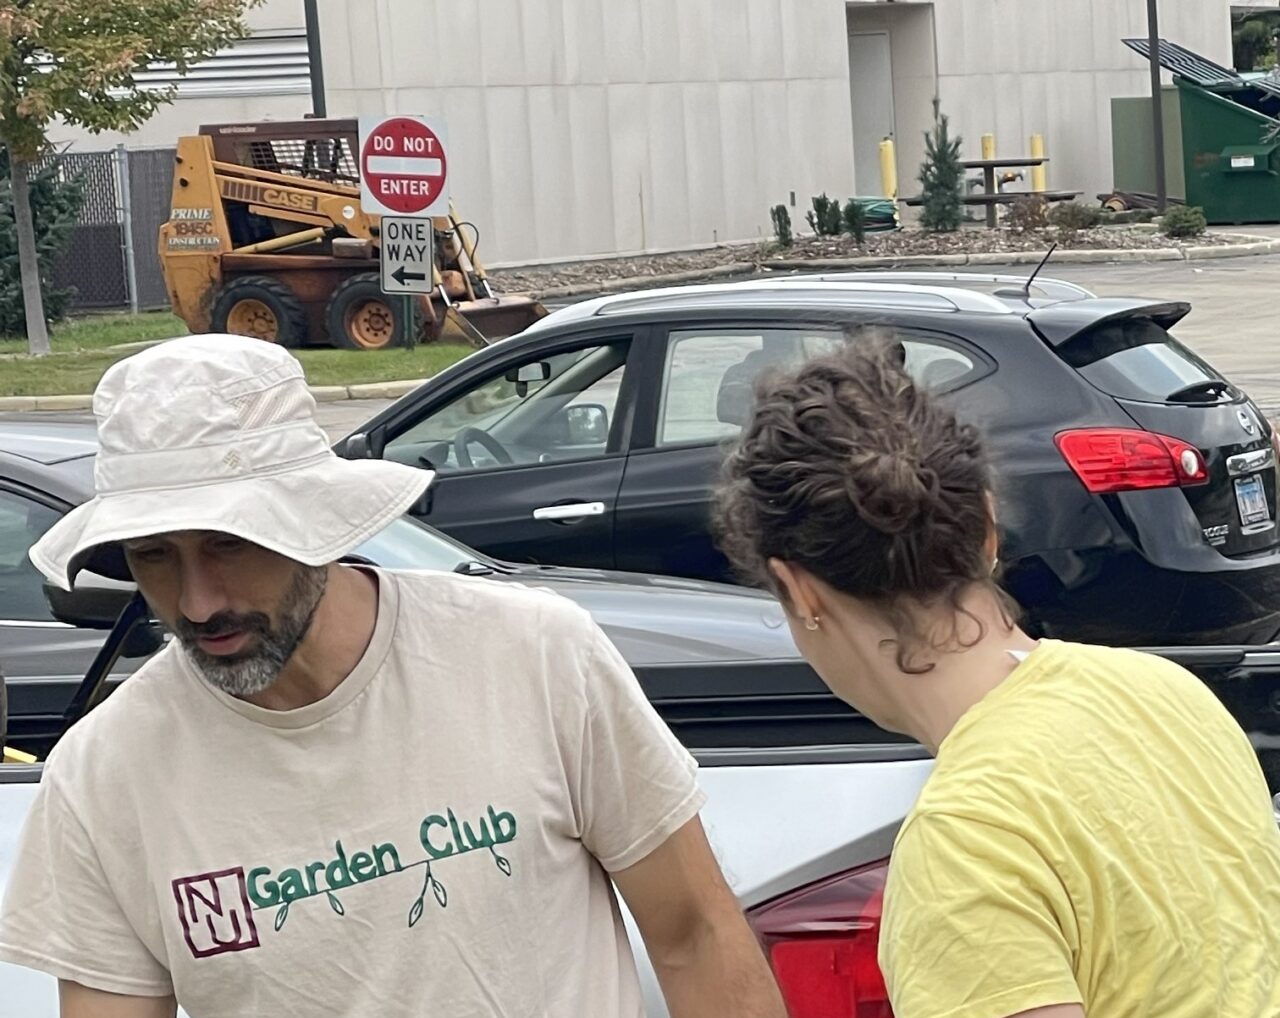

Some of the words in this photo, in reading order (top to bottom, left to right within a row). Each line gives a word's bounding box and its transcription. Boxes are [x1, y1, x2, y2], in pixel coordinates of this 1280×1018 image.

[373, 135, 394, 151] DO
[403, 136, 434, 153] NOT
[380, 178, 429, 196] ENTER
[263, 189, 315, 210] CASE
[170, 208, 213, 220] PRIME
[174, 221, 213, 236] 1845C
[387, 222, 426, 241] ONE
[386, 243, 427, 262] WAY
[180, 873, 248, 950] NU
[246, 840, 402, 909] Garden
[419, 804, 517, 860] Club
